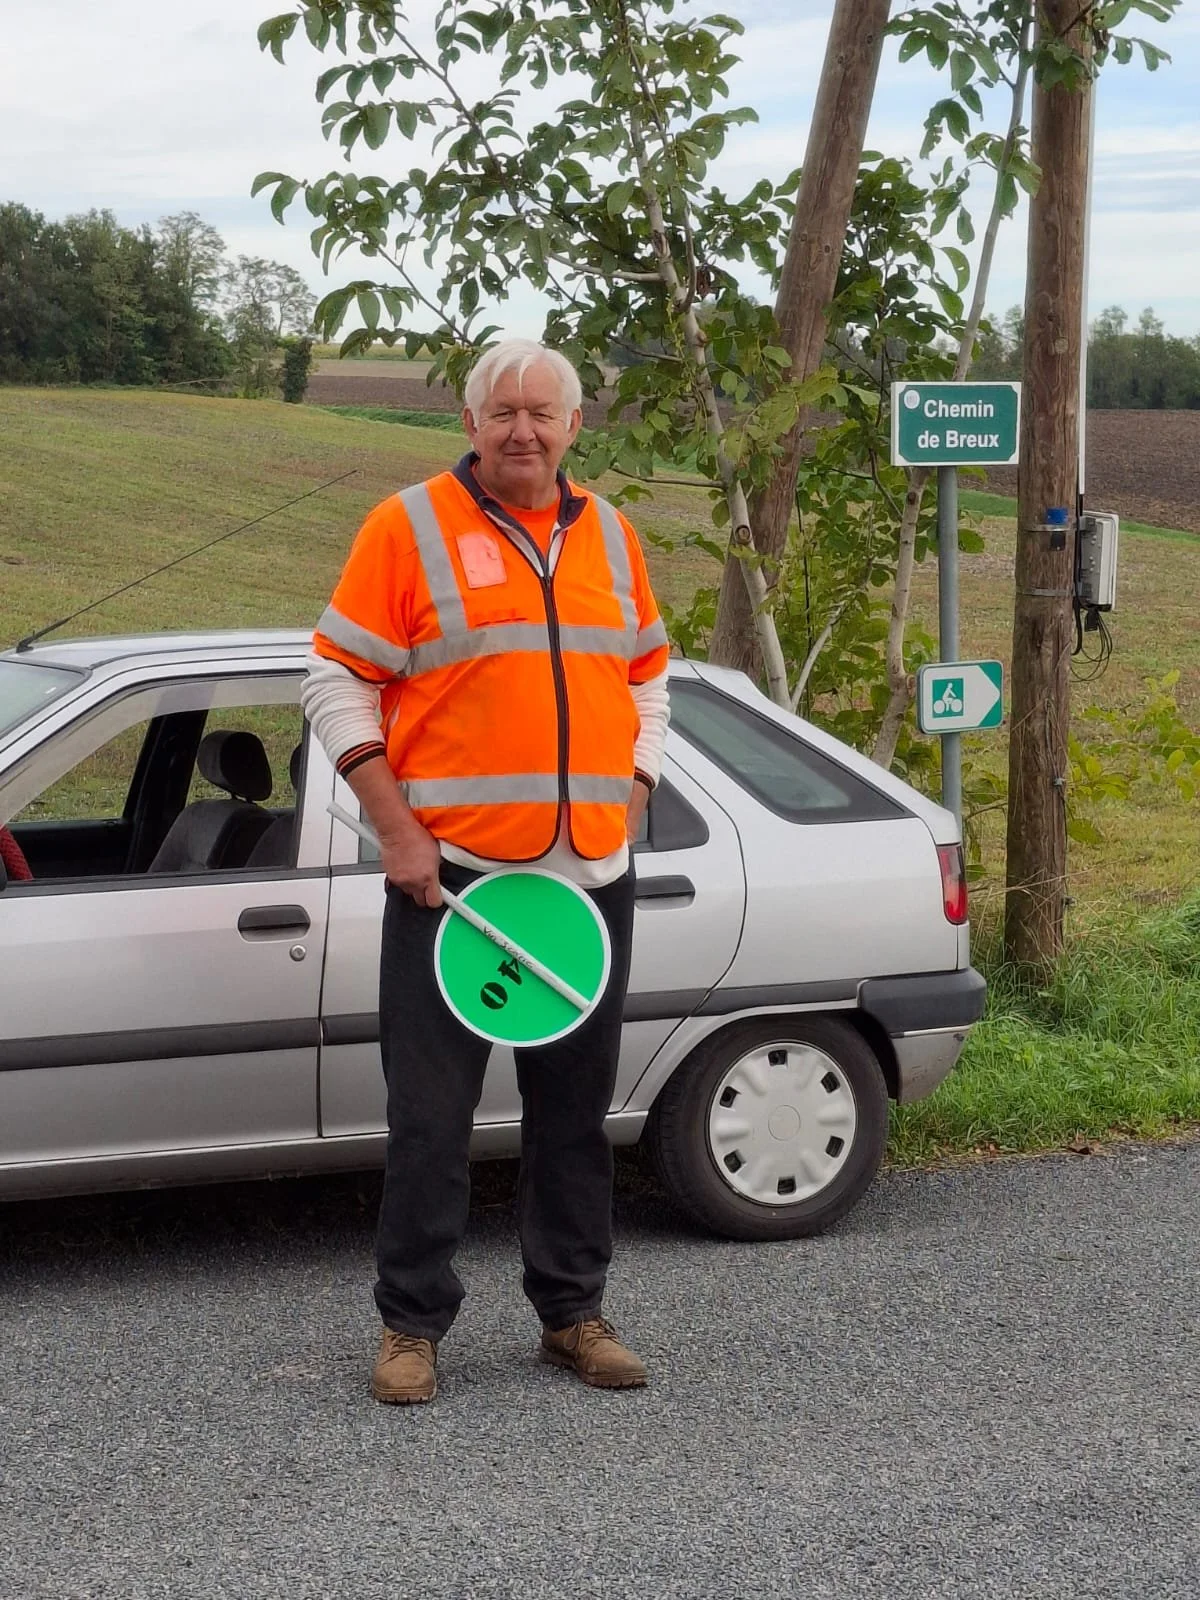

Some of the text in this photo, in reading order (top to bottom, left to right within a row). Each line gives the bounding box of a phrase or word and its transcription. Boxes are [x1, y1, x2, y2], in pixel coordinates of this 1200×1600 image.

[924, 399, 994, 418] Chemin
[917, 430, 1000, 449] de Breux
[480, 957, 522, 1010] 40
